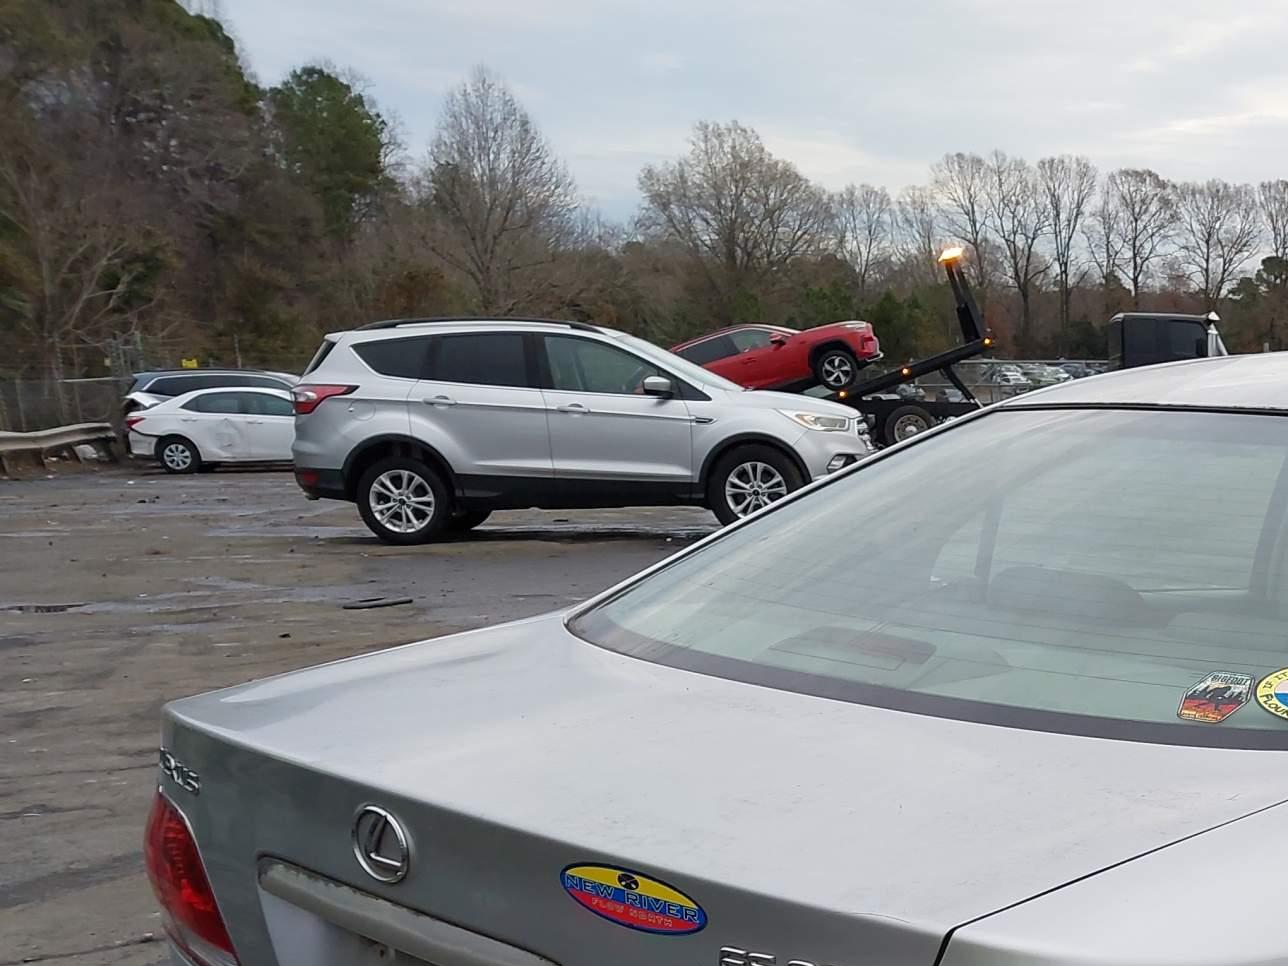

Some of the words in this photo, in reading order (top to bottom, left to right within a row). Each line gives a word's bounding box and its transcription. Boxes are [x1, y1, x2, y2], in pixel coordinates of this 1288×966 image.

[1211, 673, 1249, 686] BIGFOOT
[1262, 680, 1274, 690] IF
[1275, 673, 1288, 681] IT
[565, 874, 615, 899] NEW
[624, 889, 700, 924] RIVER
